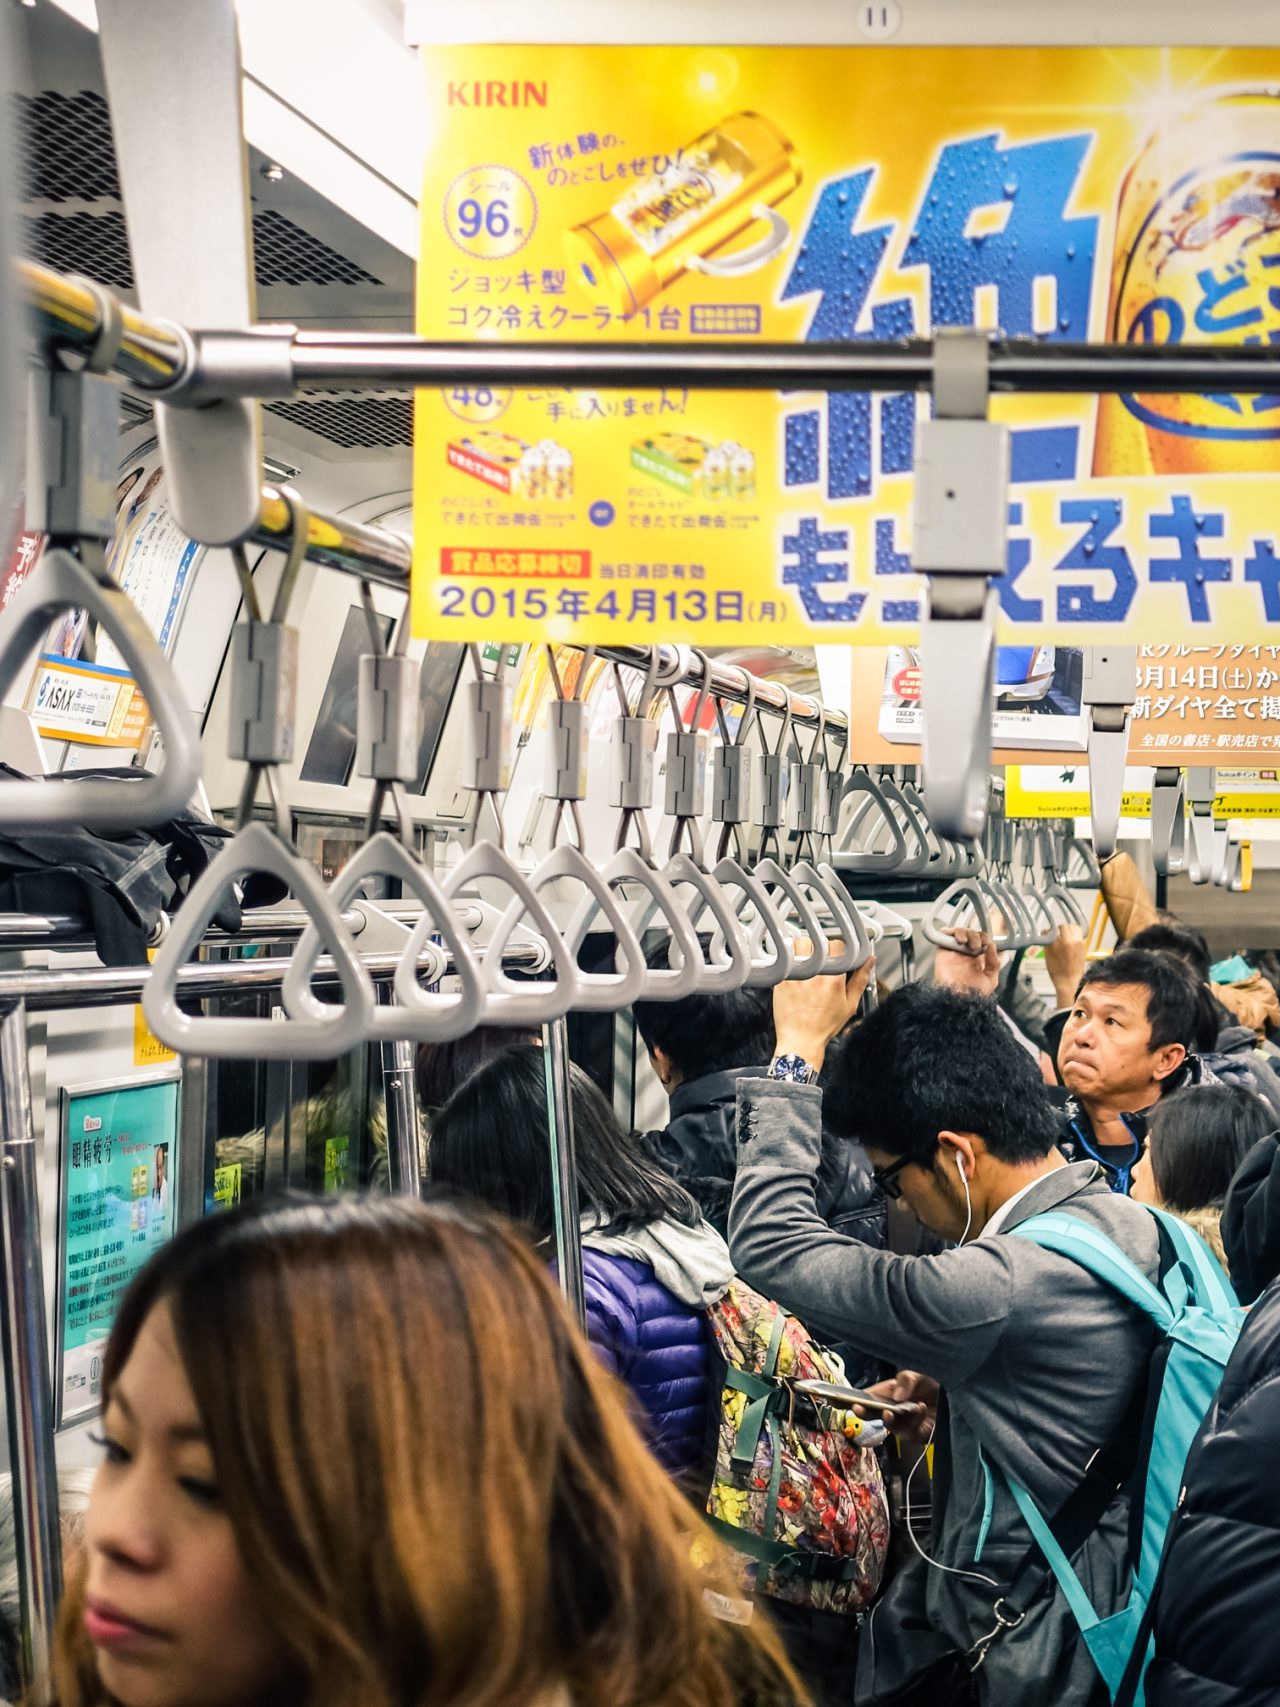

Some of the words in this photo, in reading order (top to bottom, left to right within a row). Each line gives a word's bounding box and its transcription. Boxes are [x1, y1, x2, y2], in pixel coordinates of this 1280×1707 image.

[447, 81, 549, 107] KIRIN
[449, 269, 566, 294] ジョッキ型
[440, 585, 788, 622] 2015年4月13日(月)
[45, 687, 76, 712] ASAX
